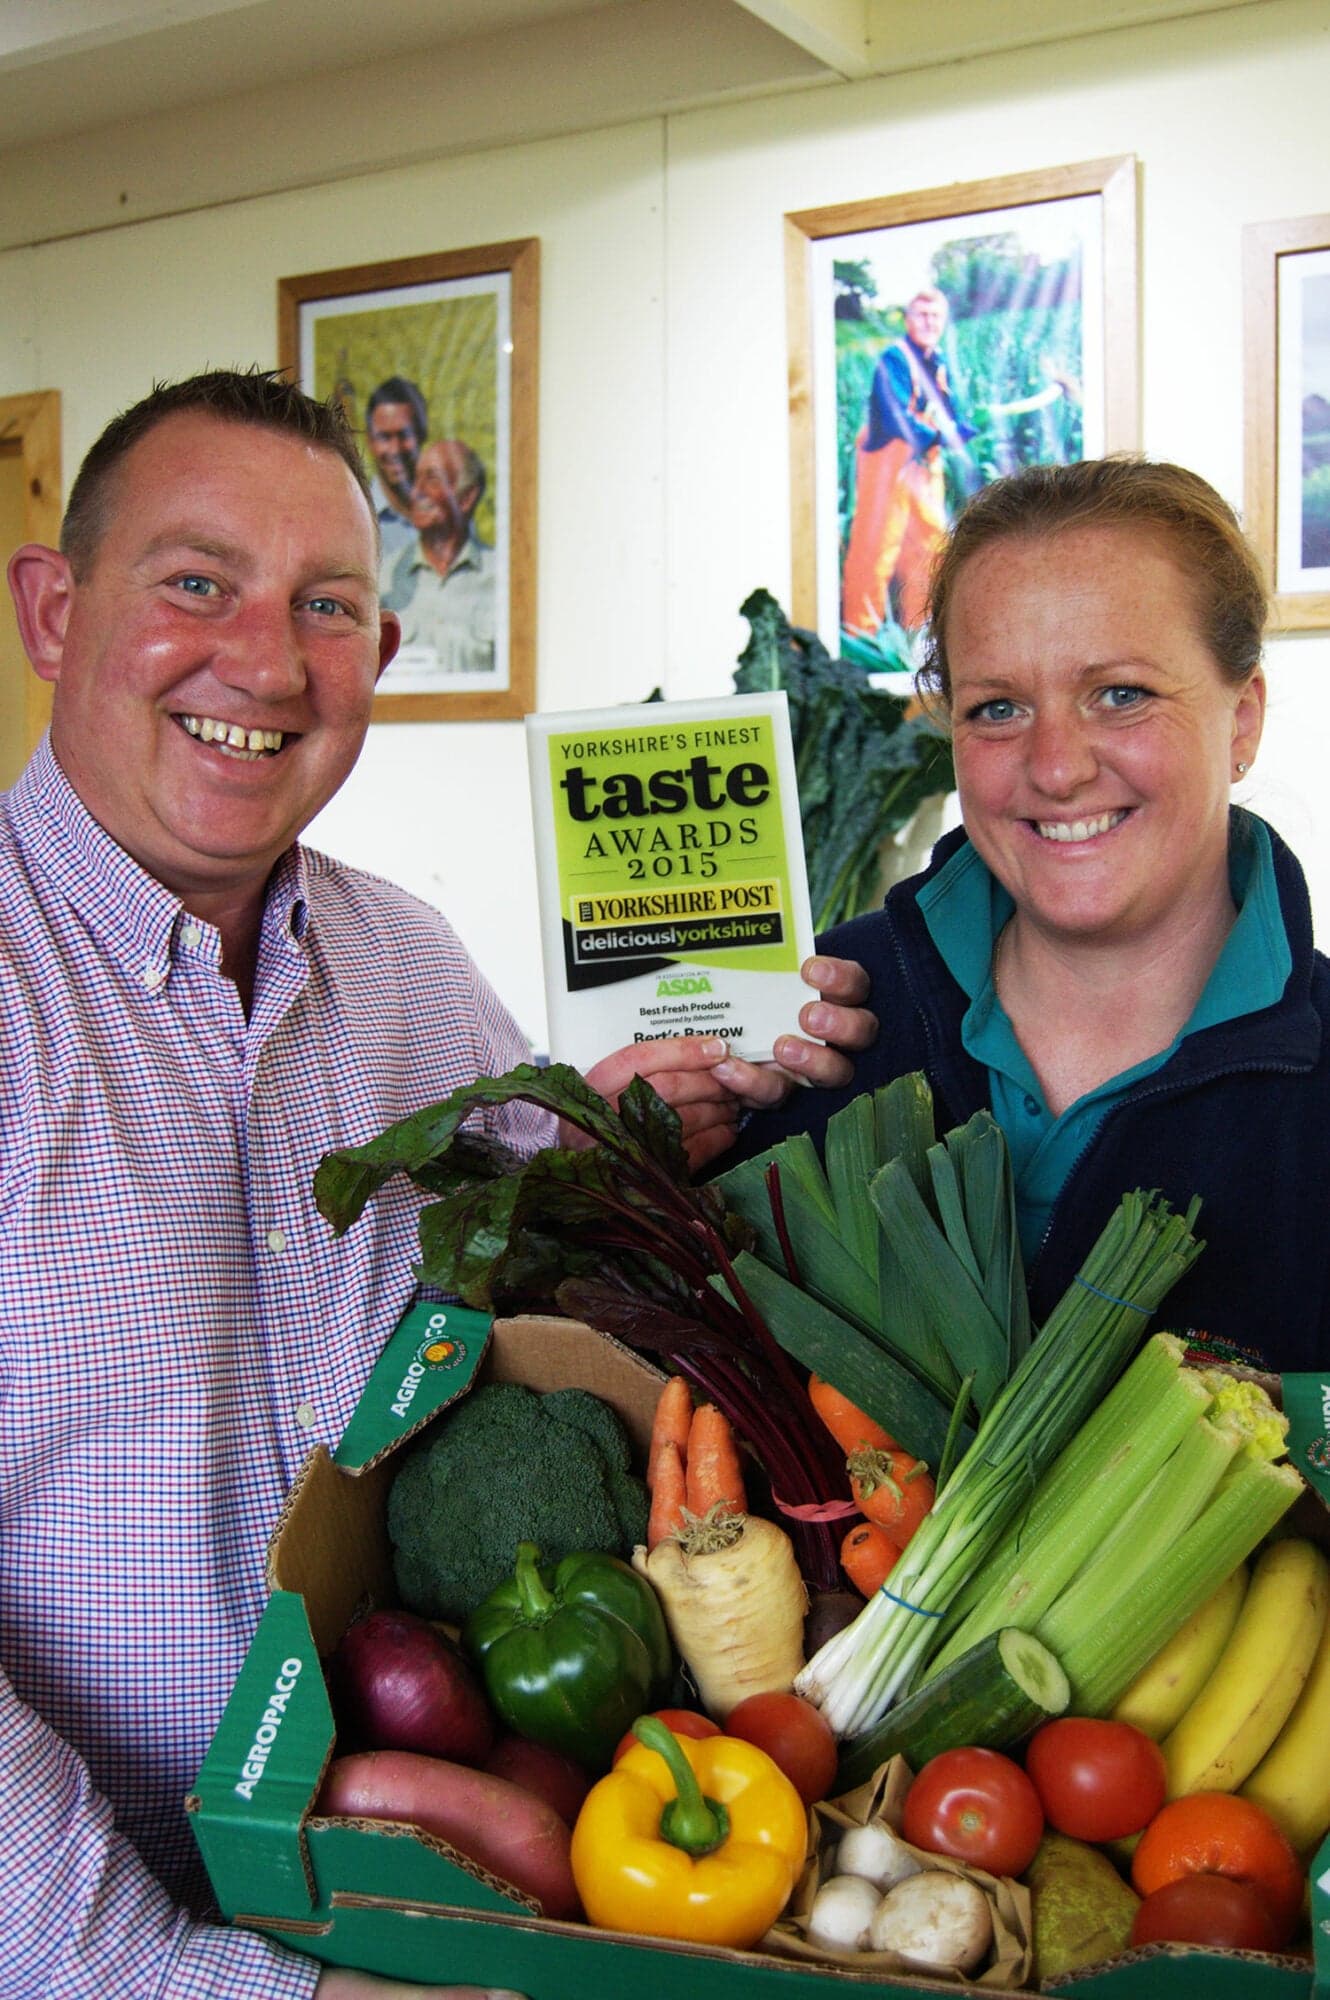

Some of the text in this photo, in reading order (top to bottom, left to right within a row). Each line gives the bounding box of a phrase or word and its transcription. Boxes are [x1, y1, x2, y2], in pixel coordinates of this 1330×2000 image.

[561, 726, 761, 760] YORKSHIRE'S FINEST
[560, 755, 770, 822] taste
[583, 818, 759, 858] AWARDS
[627, 851, 718, 880] 2015
[581, 884, 774, 921] THE YORKSHIRE POST
[656, 976, 713, 998] ASDA
[639, 1000, 731, 1017] Best Fresh Produce
[650, 1016, 683, 1026] sponsored
[234, 1656, 303, 1801] AGROPACO
